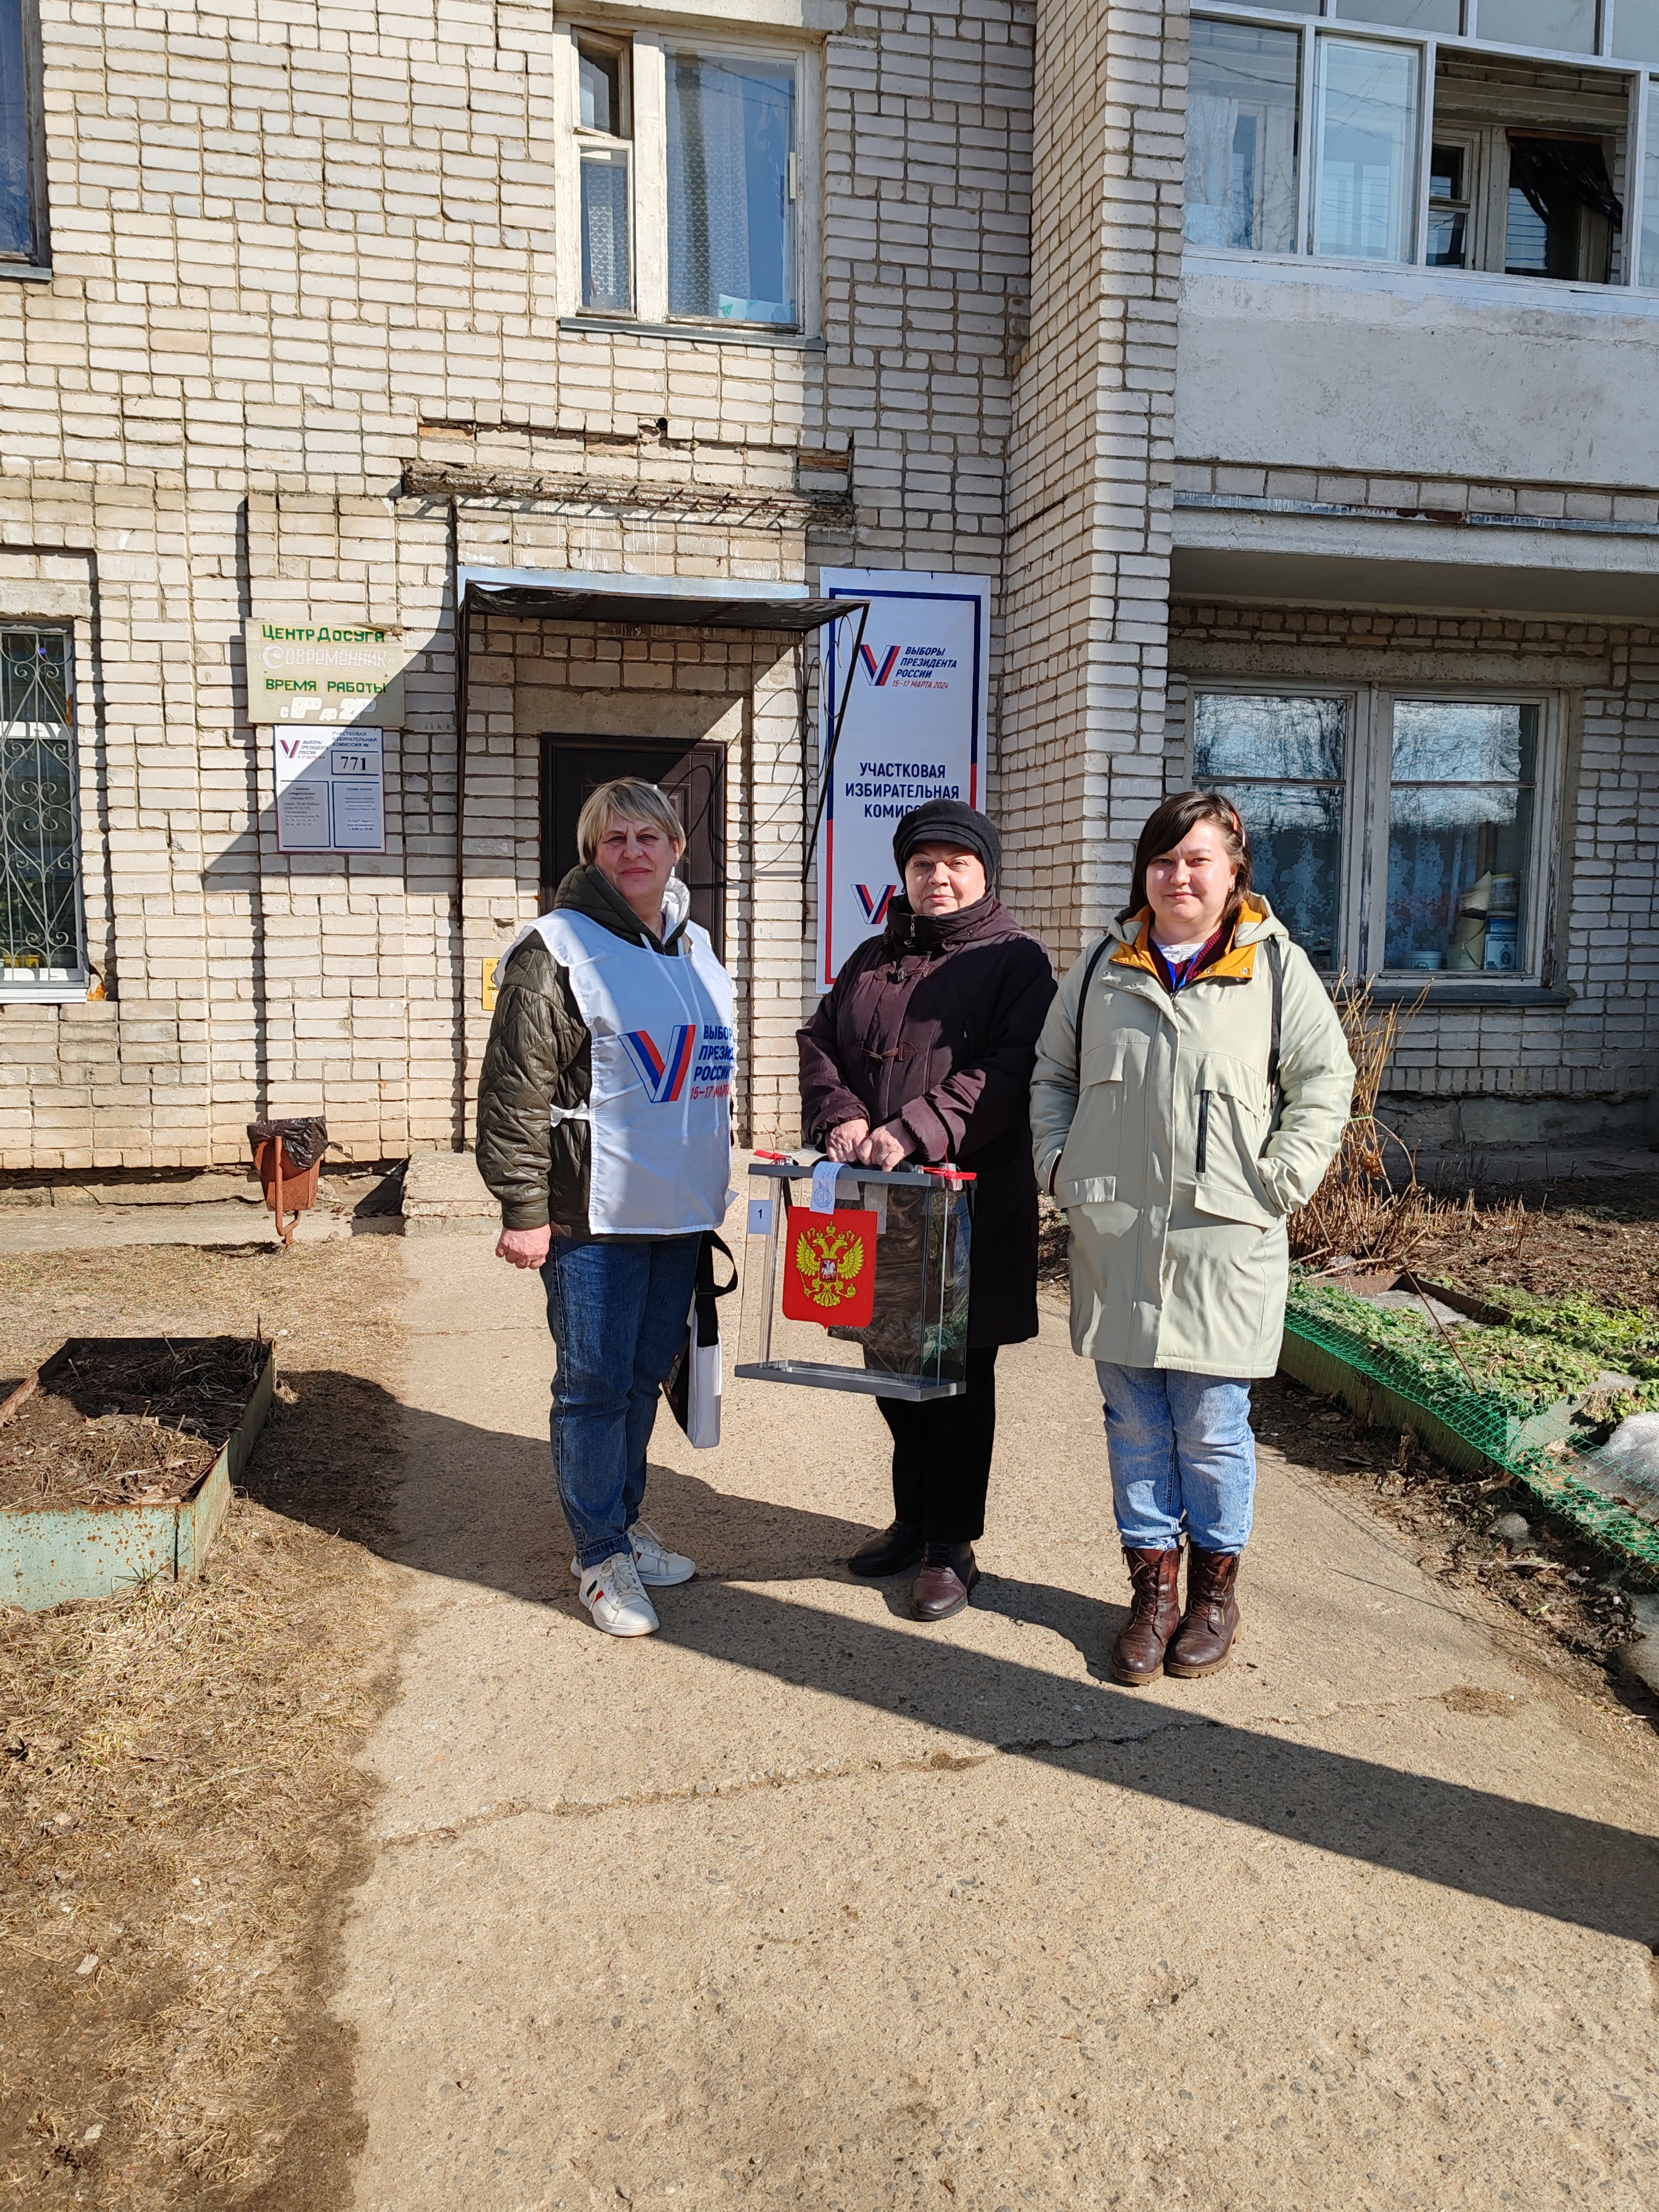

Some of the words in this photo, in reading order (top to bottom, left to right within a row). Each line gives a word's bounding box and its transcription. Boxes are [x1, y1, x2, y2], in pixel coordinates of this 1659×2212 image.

[262, 624, 315, 641] ЦЕНТР
[317, 627, 386, 643] ДОСУГА
[905, 646, 945, 656] ВЫБОРЫ
[900, 658, 957, 668] ПРЕЗИДЕНТА
[895, 669, 932, 678] РОССИИ
[266, 678, 317, 692] ВРЕМЯ
[327, 681, 386, 694] РАБОТЫ
[910, 680, 932, 689] МАРТА
[933, 681, 949, 690] 2024
[340, 756, 367, 771] 771
[859, 763, 945, 778] УЧАСТКОВАЯ
[845, 783, 959, 799] ИЗБИРАТЕЛЬНАЯ
[864, 803, 921, 818] КОМИС
[703, 1025, 734, 1041] ВЫБОР
[758, 1208, 763, 1219] 1
